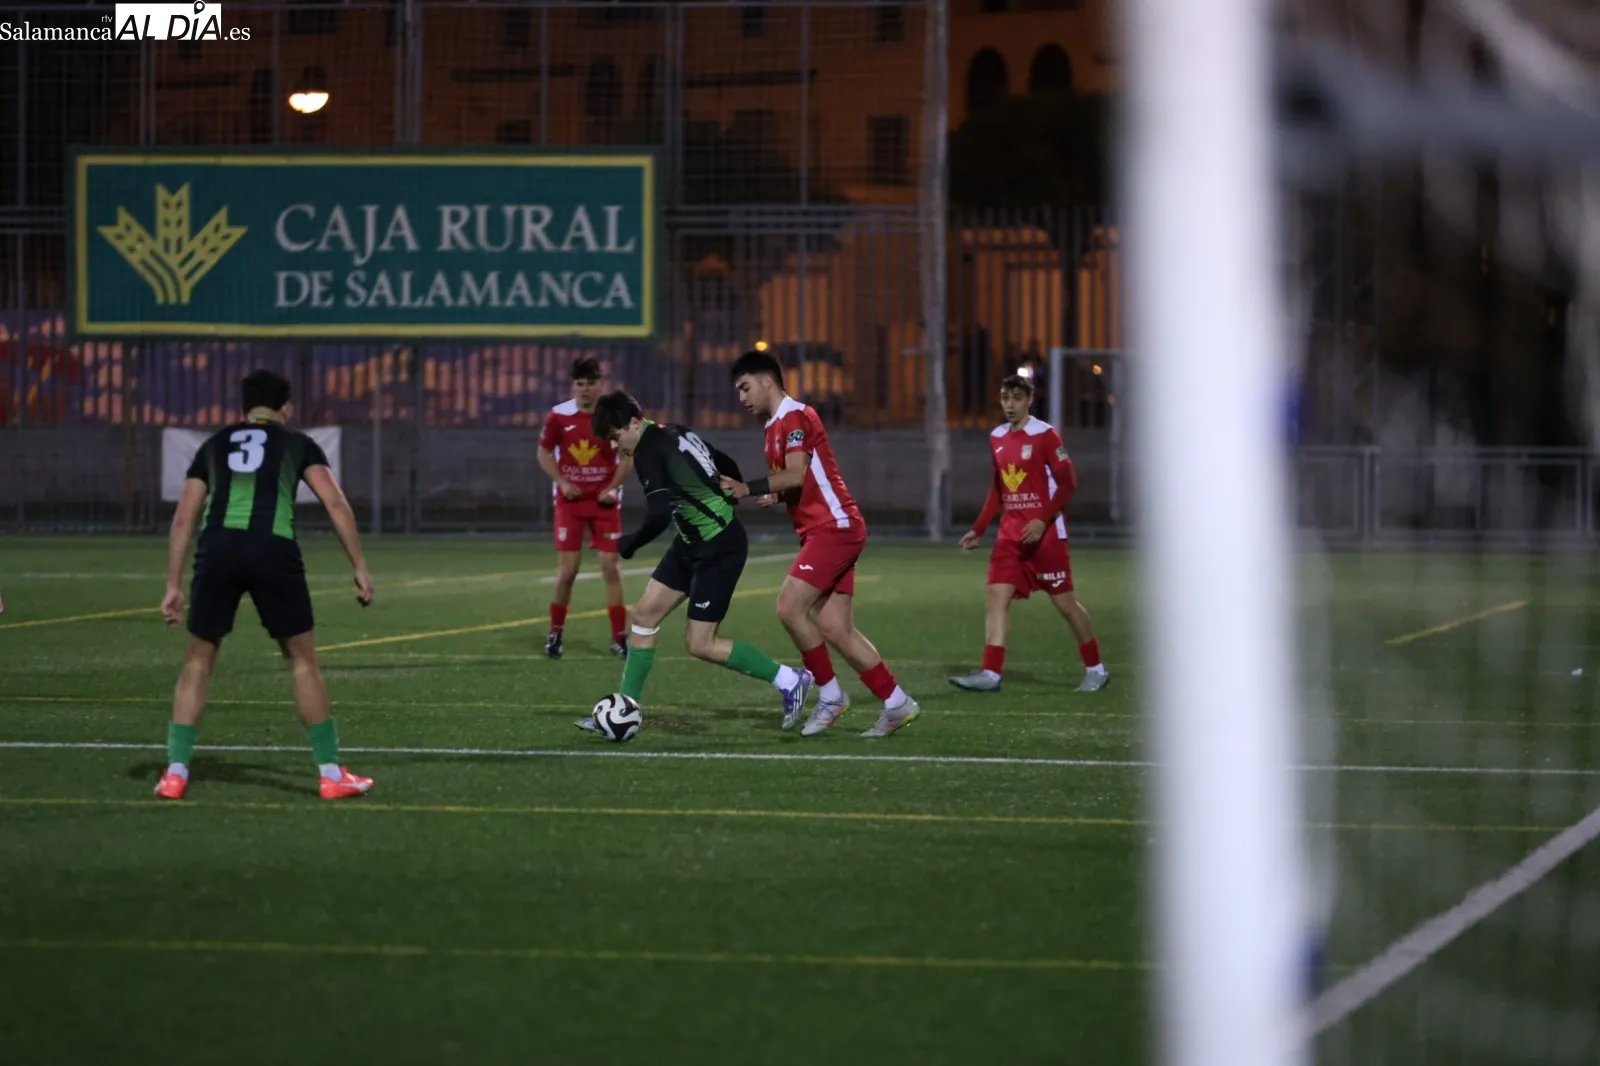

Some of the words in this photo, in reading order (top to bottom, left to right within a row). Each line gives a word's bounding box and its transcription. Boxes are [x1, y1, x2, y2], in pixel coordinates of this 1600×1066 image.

[274, 203, 419, 266] CAJA
[437, 204, 637, 254] RURAL
[275, 271, 335, 308] DE
[345, 269, 635, 309] SALAMANCA
[227, 428, 268, 473] 3
